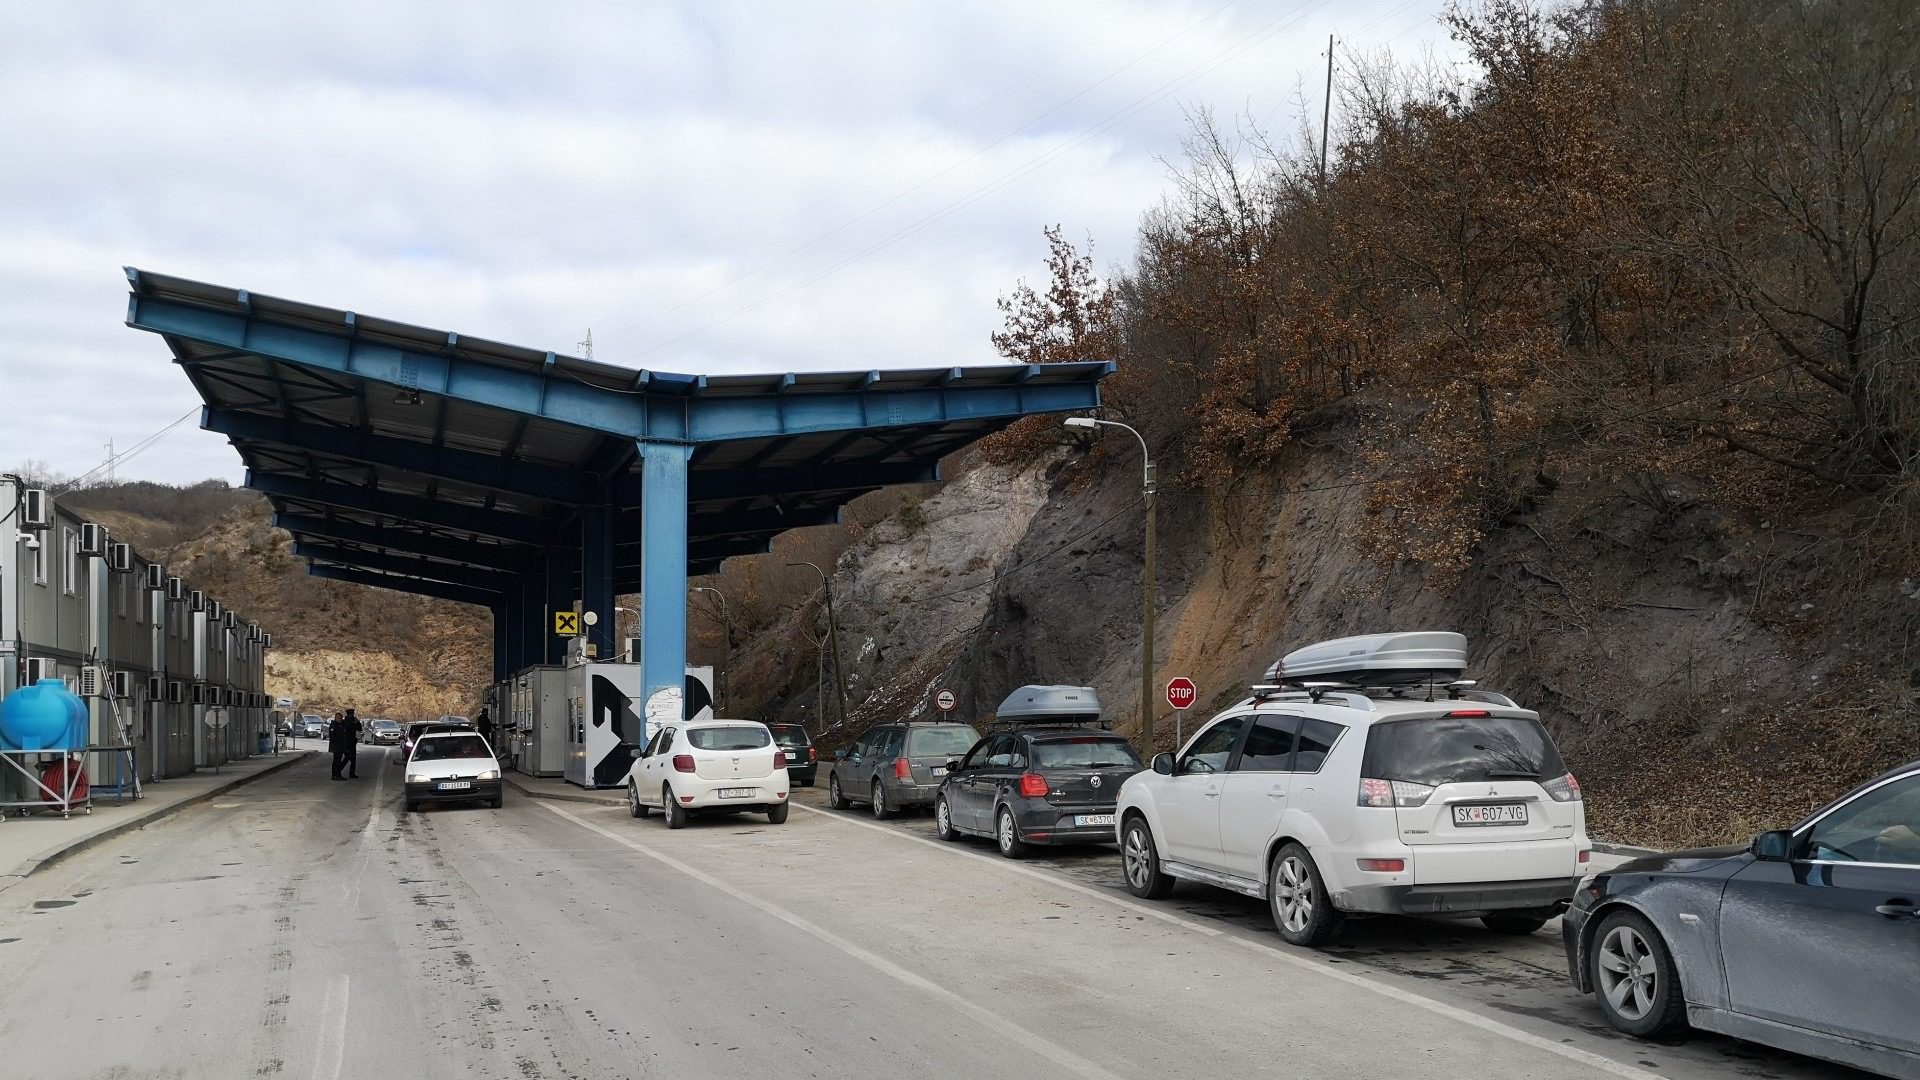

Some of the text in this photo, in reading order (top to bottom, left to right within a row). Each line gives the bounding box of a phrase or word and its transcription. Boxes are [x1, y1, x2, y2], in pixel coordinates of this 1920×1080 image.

[1170, 687, 1192, 699] STOP
[1080, 816, 1089, 824] SK
[1458, 807, 1473, 821] SK
